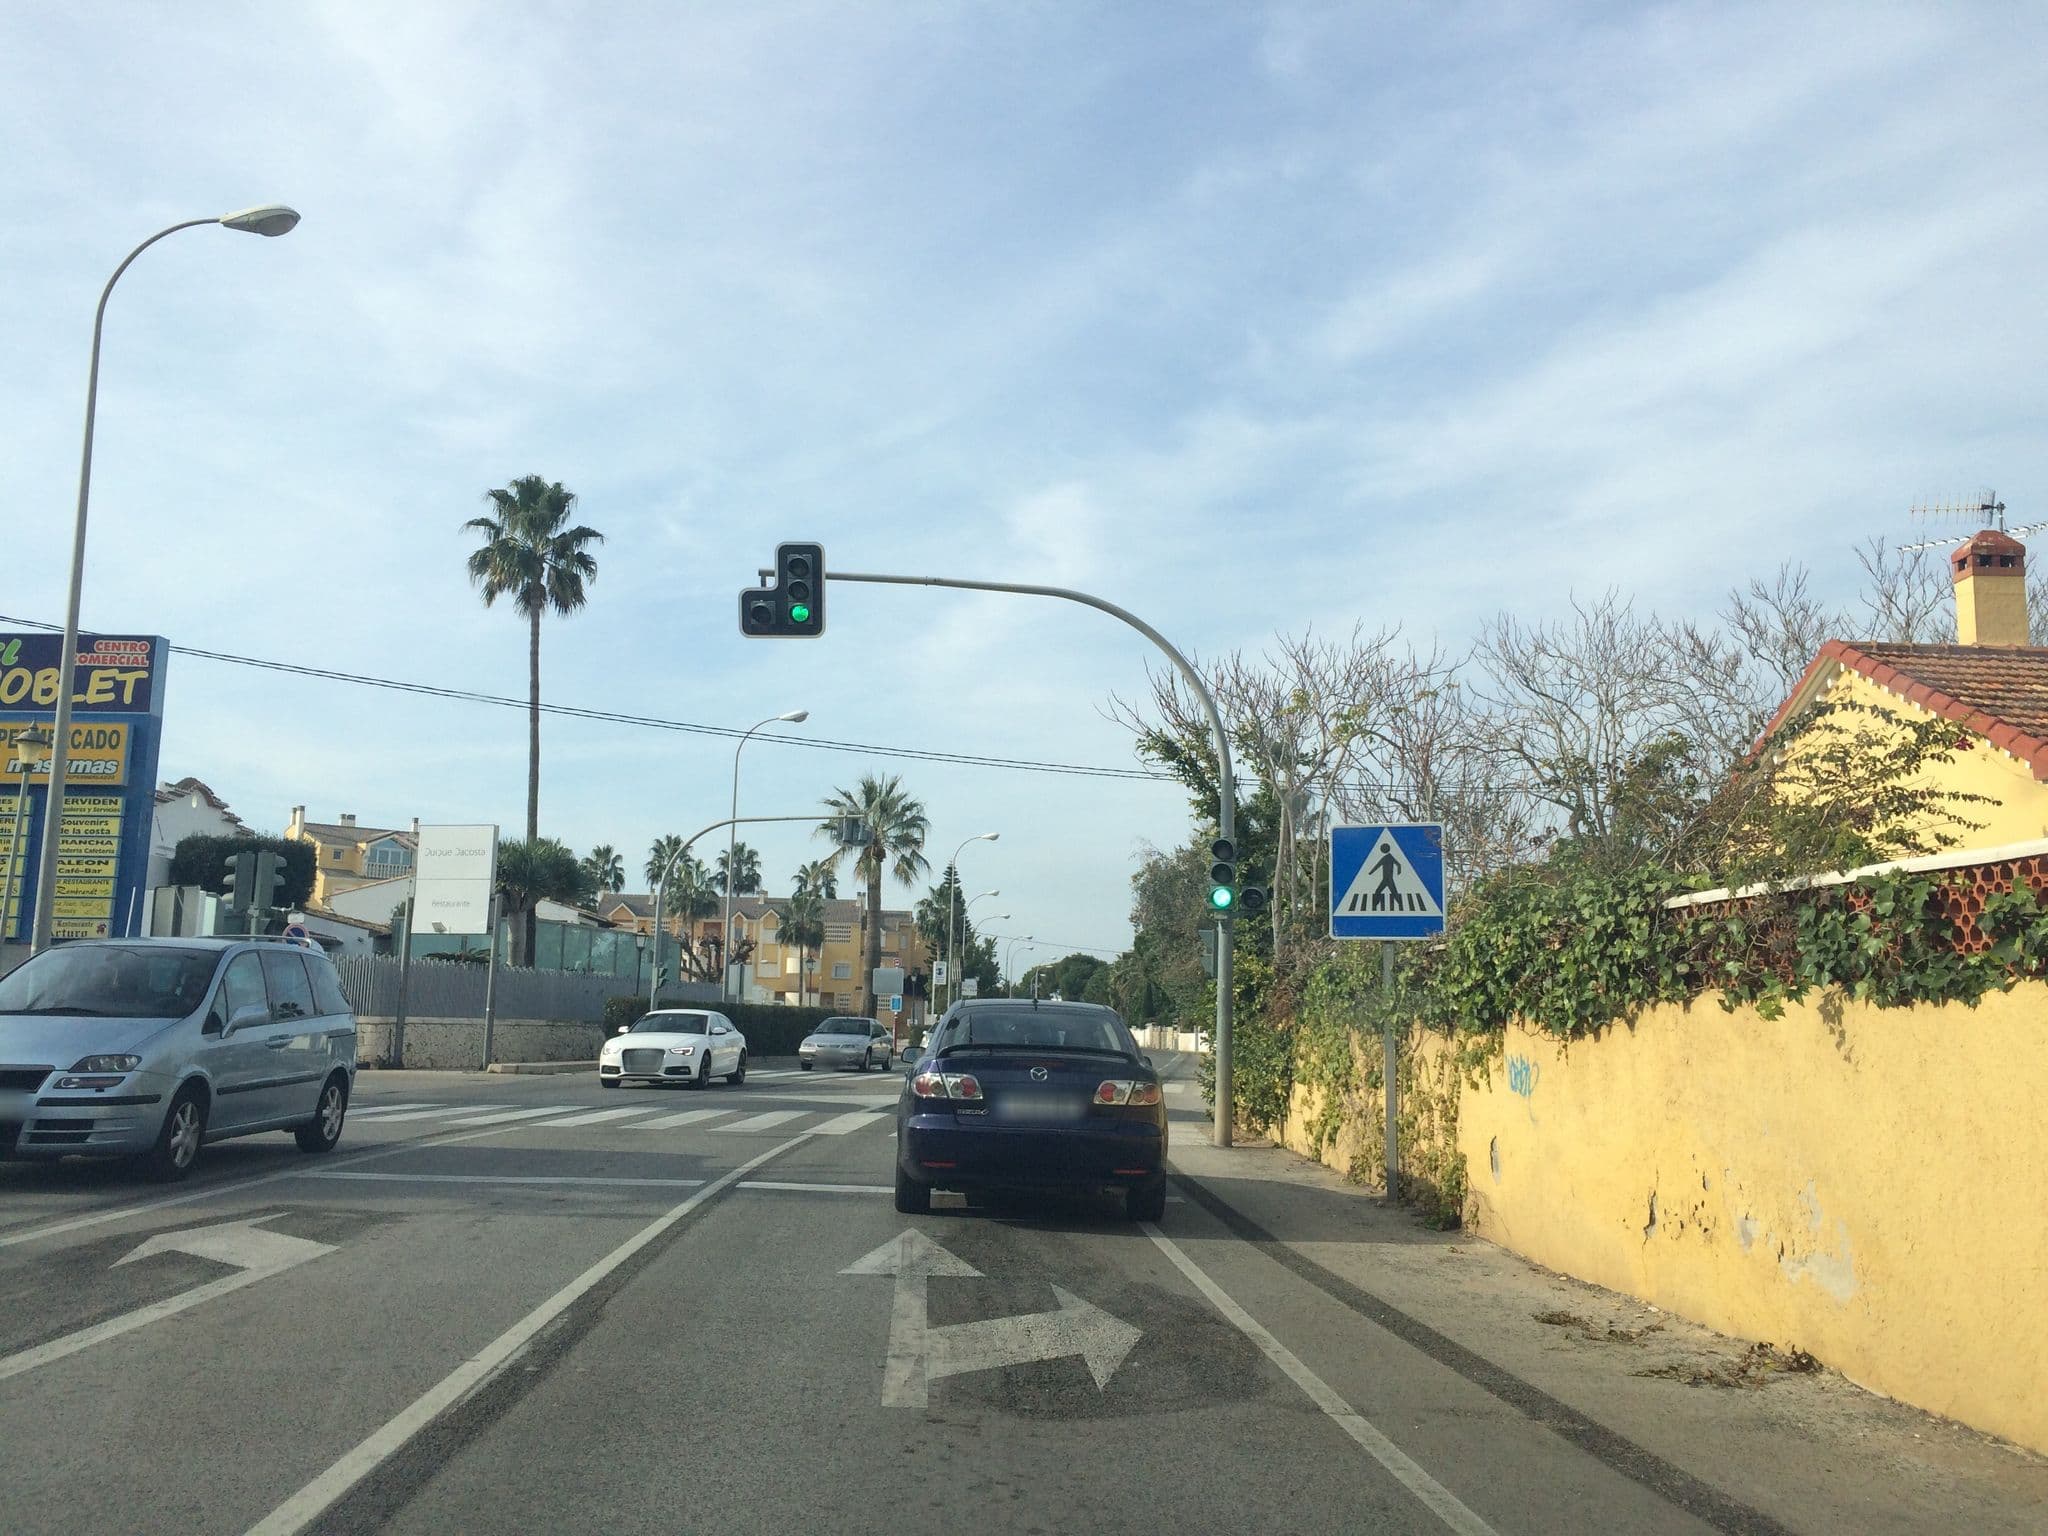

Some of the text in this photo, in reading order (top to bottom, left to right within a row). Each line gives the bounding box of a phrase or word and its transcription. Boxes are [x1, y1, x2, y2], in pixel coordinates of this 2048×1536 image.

[94, 640, 150, 653] CENTRO
[75, 653, 149, 667] OMERCIAL
[0, 667, 149, 705] OBET
[6, 758, 119, 774] msmas
[64, 798, 119, 806] ERVIDEN
[60, 818, 109, 826] Souvenirs
